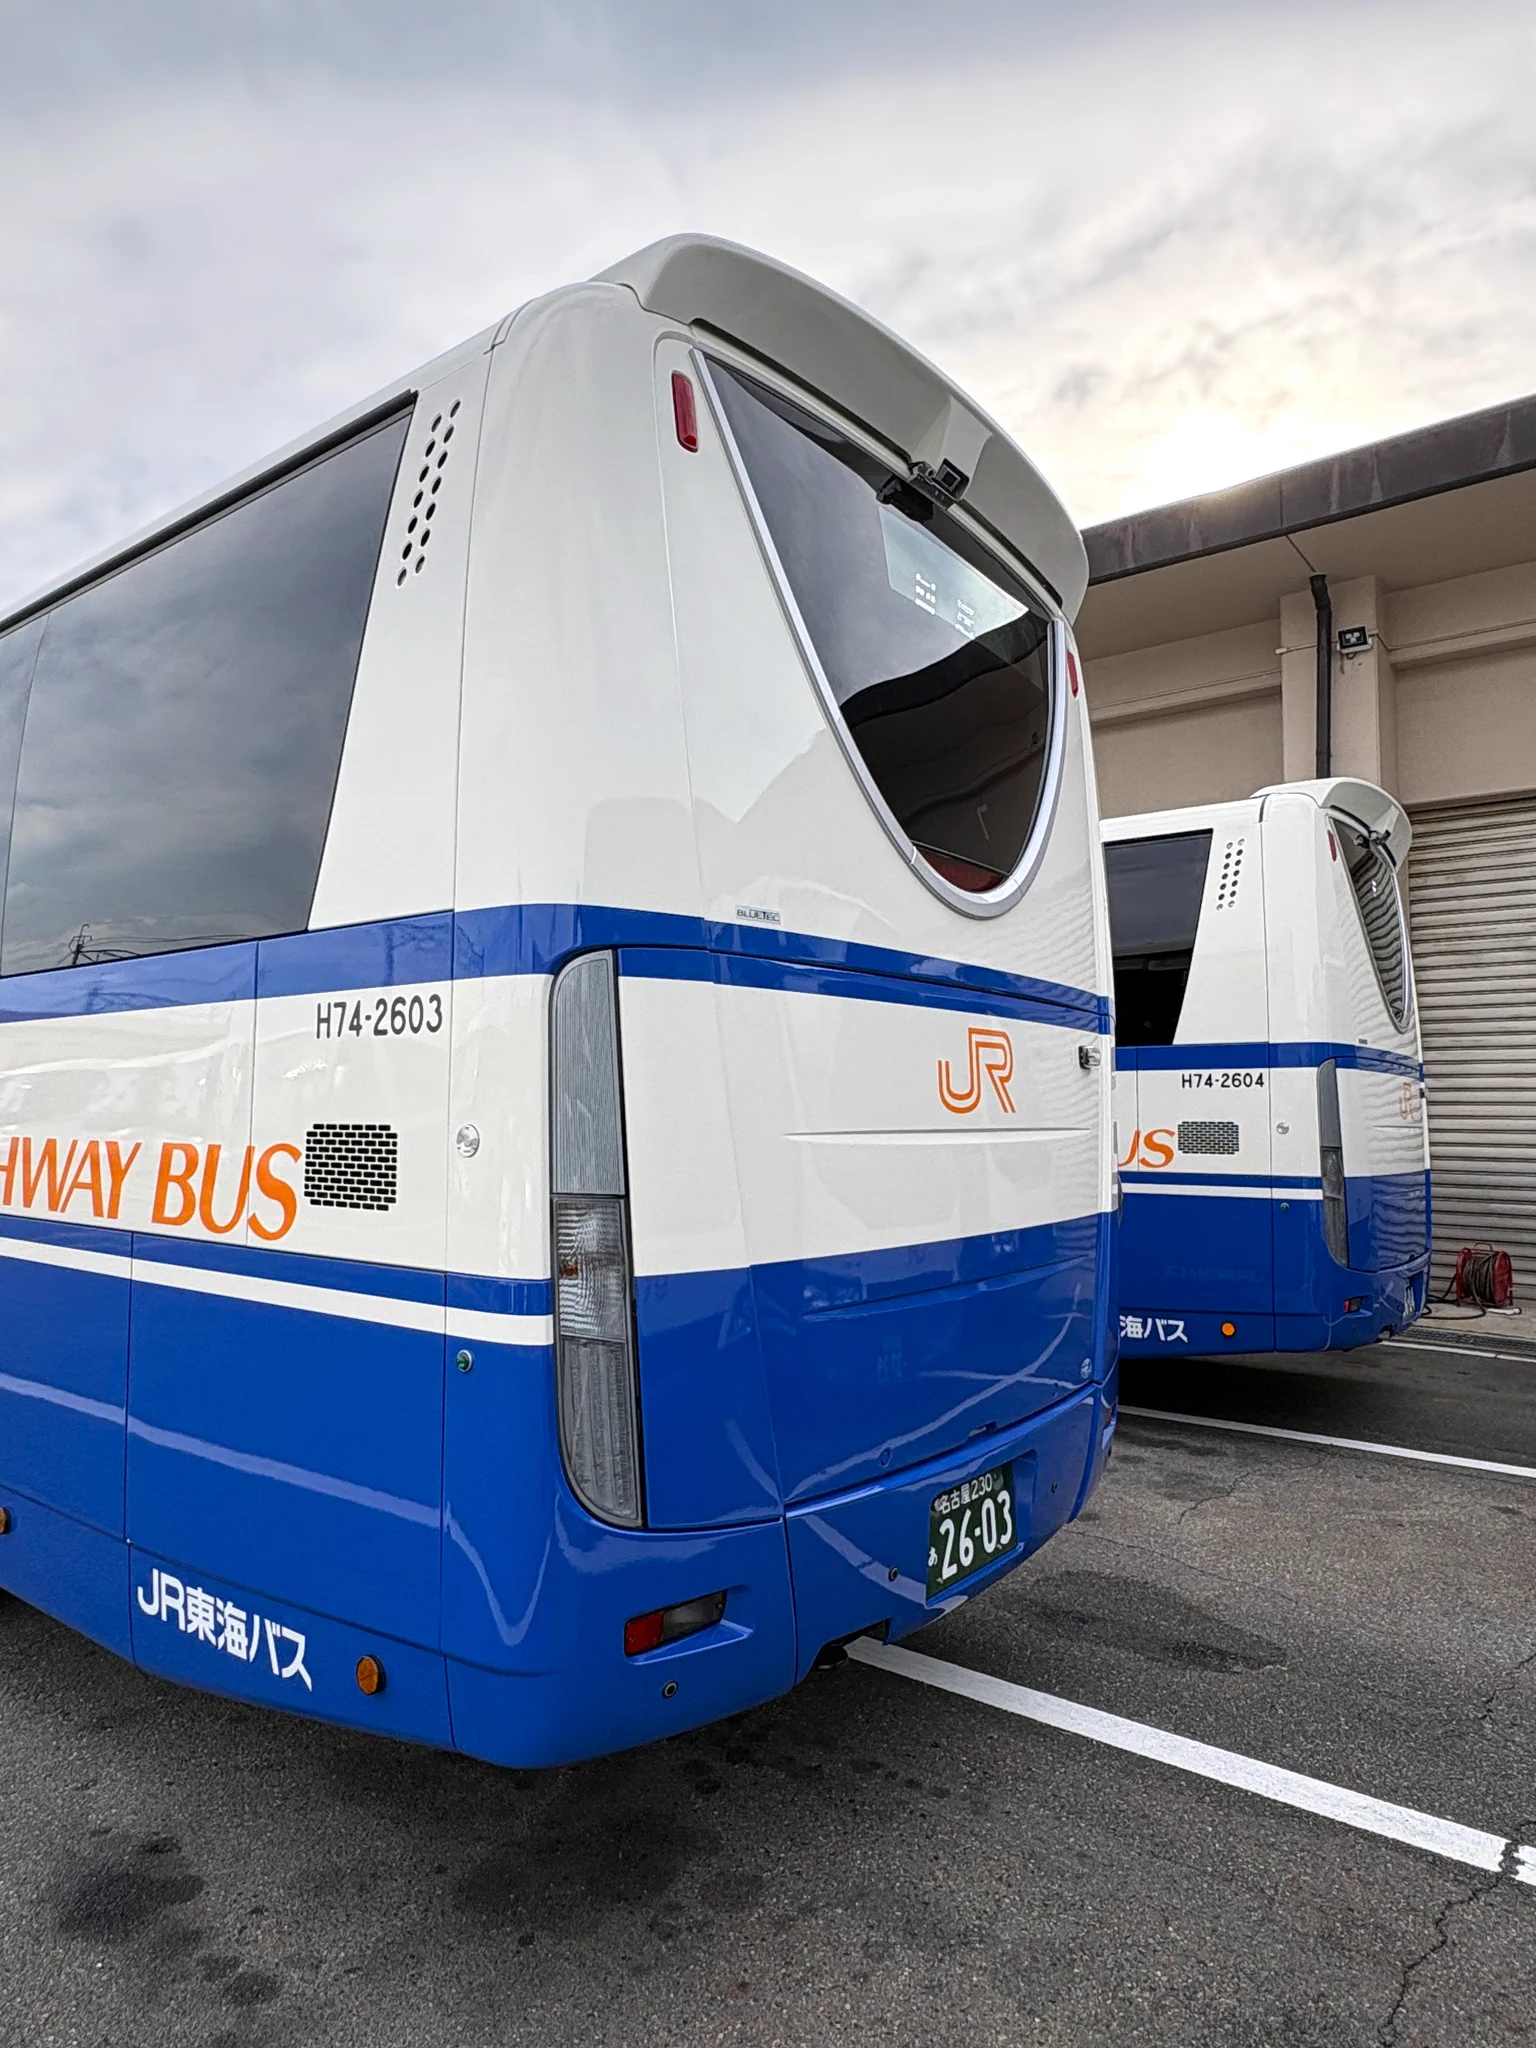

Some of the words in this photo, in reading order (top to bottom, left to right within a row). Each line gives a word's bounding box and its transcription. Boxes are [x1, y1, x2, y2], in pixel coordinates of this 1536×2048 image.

[316, 993, 443, 1039] H74-2603
[937, 1027, 1016, 1114] JR
[1181, 1072, 1265, 1089] H74-2604
[151, 1142, 303, 1241] BUS
[1118, 1314, 1189, 1343] 海バス
[939, 1489, 1013, 1580] 26-03
[137, 1568, 313, 1692] JR東海バス
